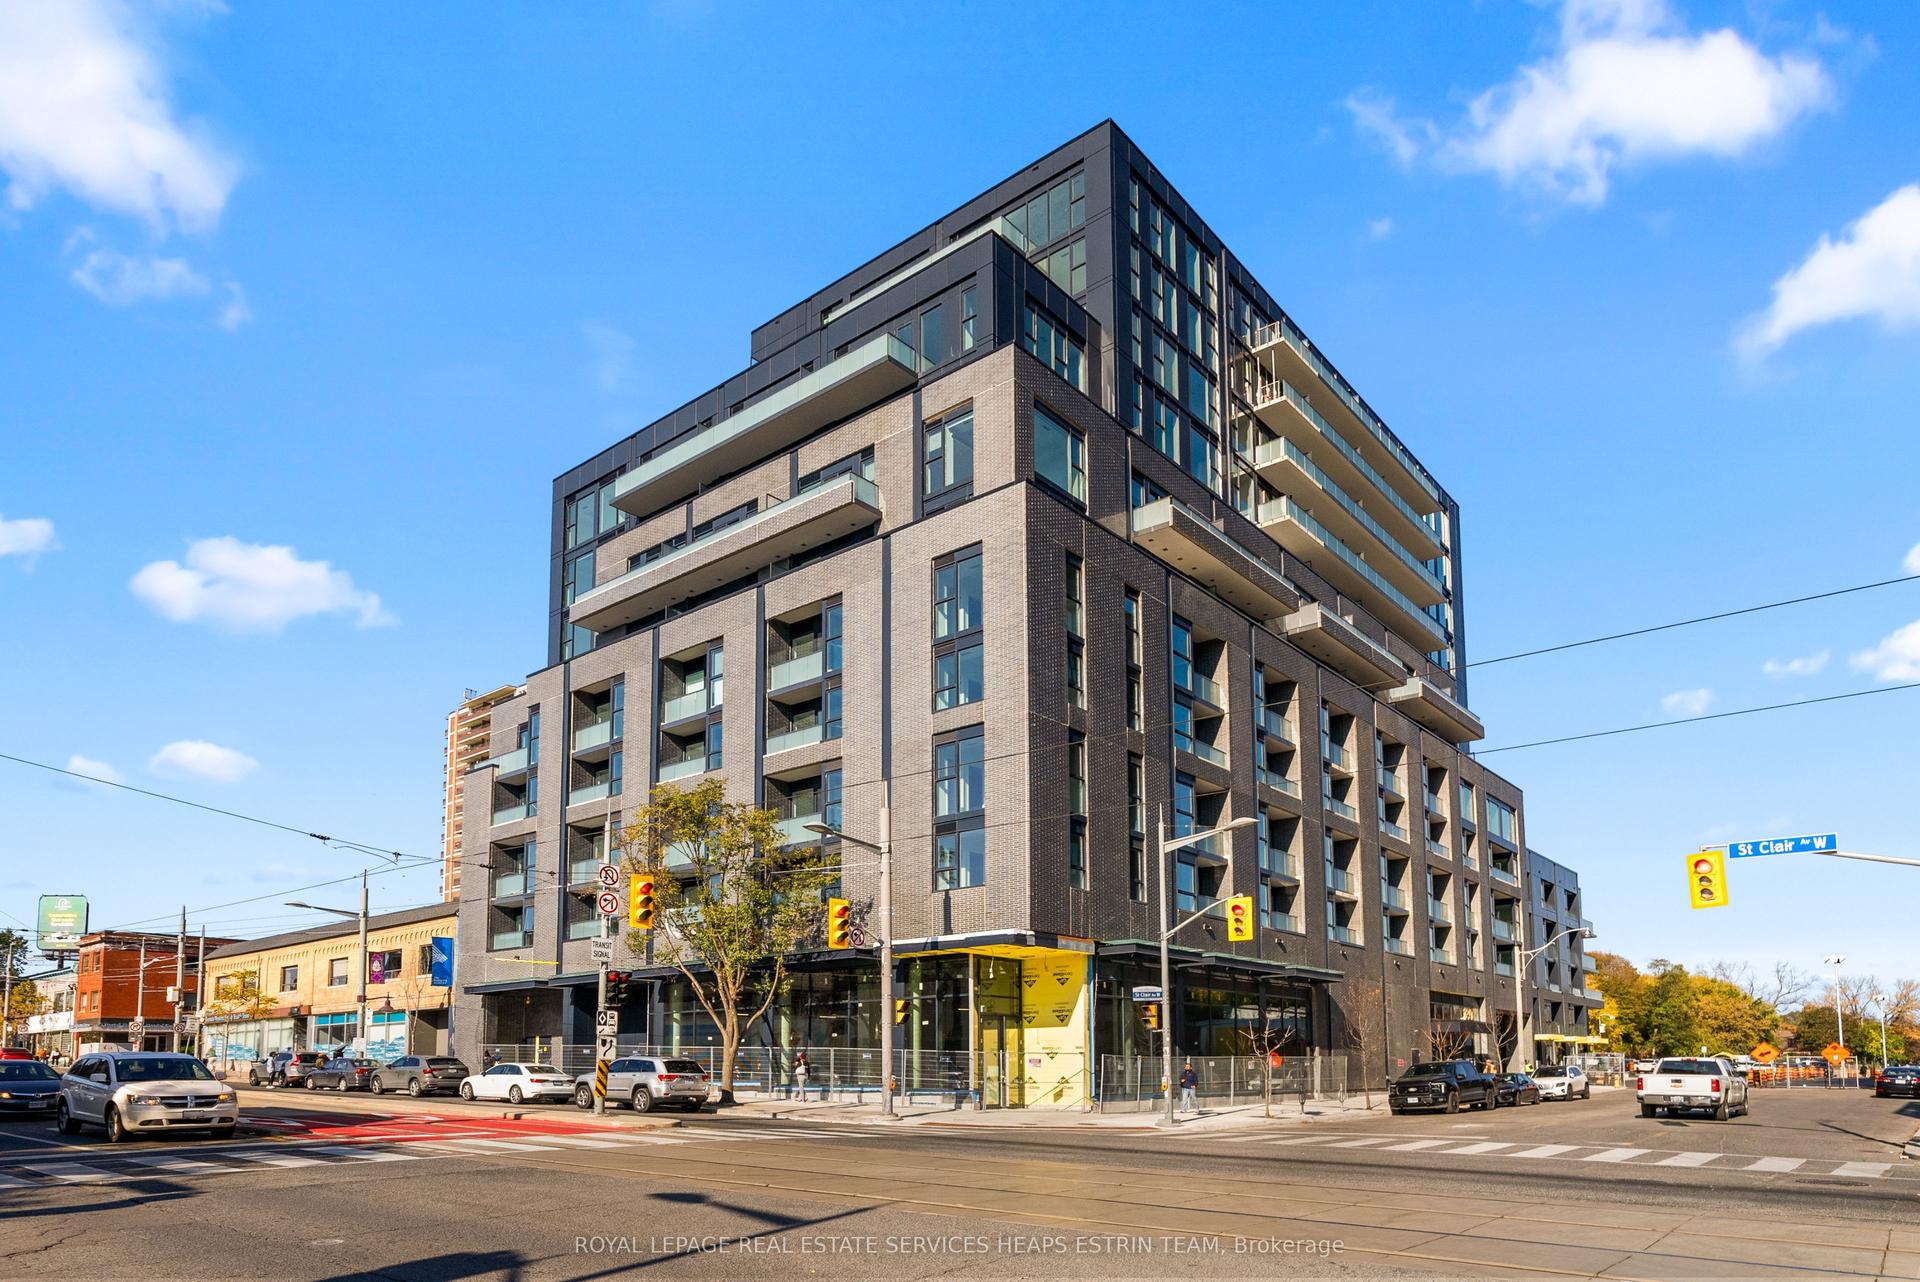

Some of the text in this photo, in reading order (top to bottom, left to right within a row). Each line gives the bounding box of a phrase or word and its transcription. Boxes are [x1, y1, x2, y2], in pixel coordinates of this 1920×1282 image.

[1738, 843, 1753, 856] St
[1759, 840, 1795, 854] Clair
[1813, 836, 1826, 849] W
[592, 941, 612, 949] TRANSIT
[593, 950, 611, 958] SIGNAL
